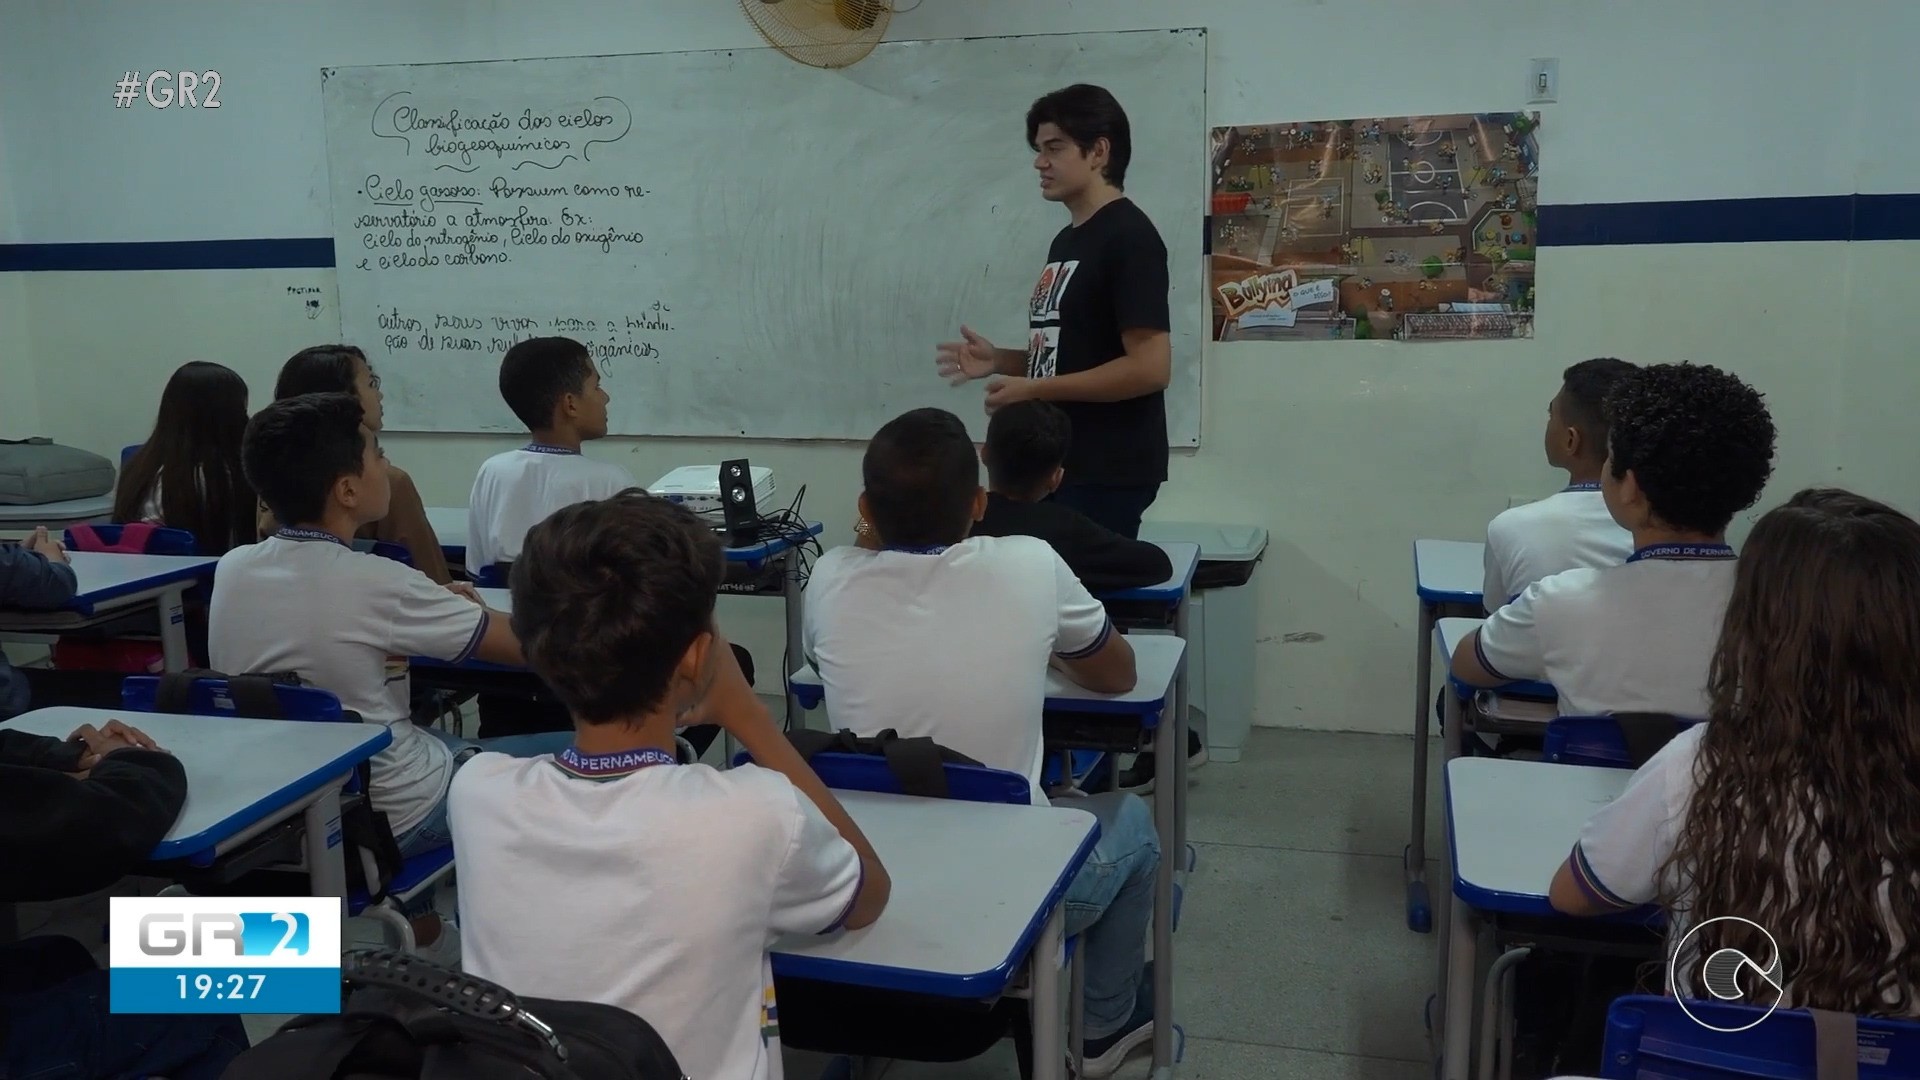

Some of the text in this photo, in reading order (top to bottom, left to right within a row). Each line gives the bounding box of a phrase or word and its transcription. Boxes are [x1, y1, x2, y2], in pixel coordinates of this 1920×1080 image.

[393, 106, 613, 137] Classificação dos ciclos
[425, 134, 571, 165] biogeoquímicos
[365, 174, 414, 201] Ciclo
[573, 184, 620, 197] como
[446, 214, 458, 227] a
[406, 228, 421, 247] do
[551, 227, 571, 244] do
[575, 227, 643, 253] oxigênio
[356, 258, 372, 271] e
